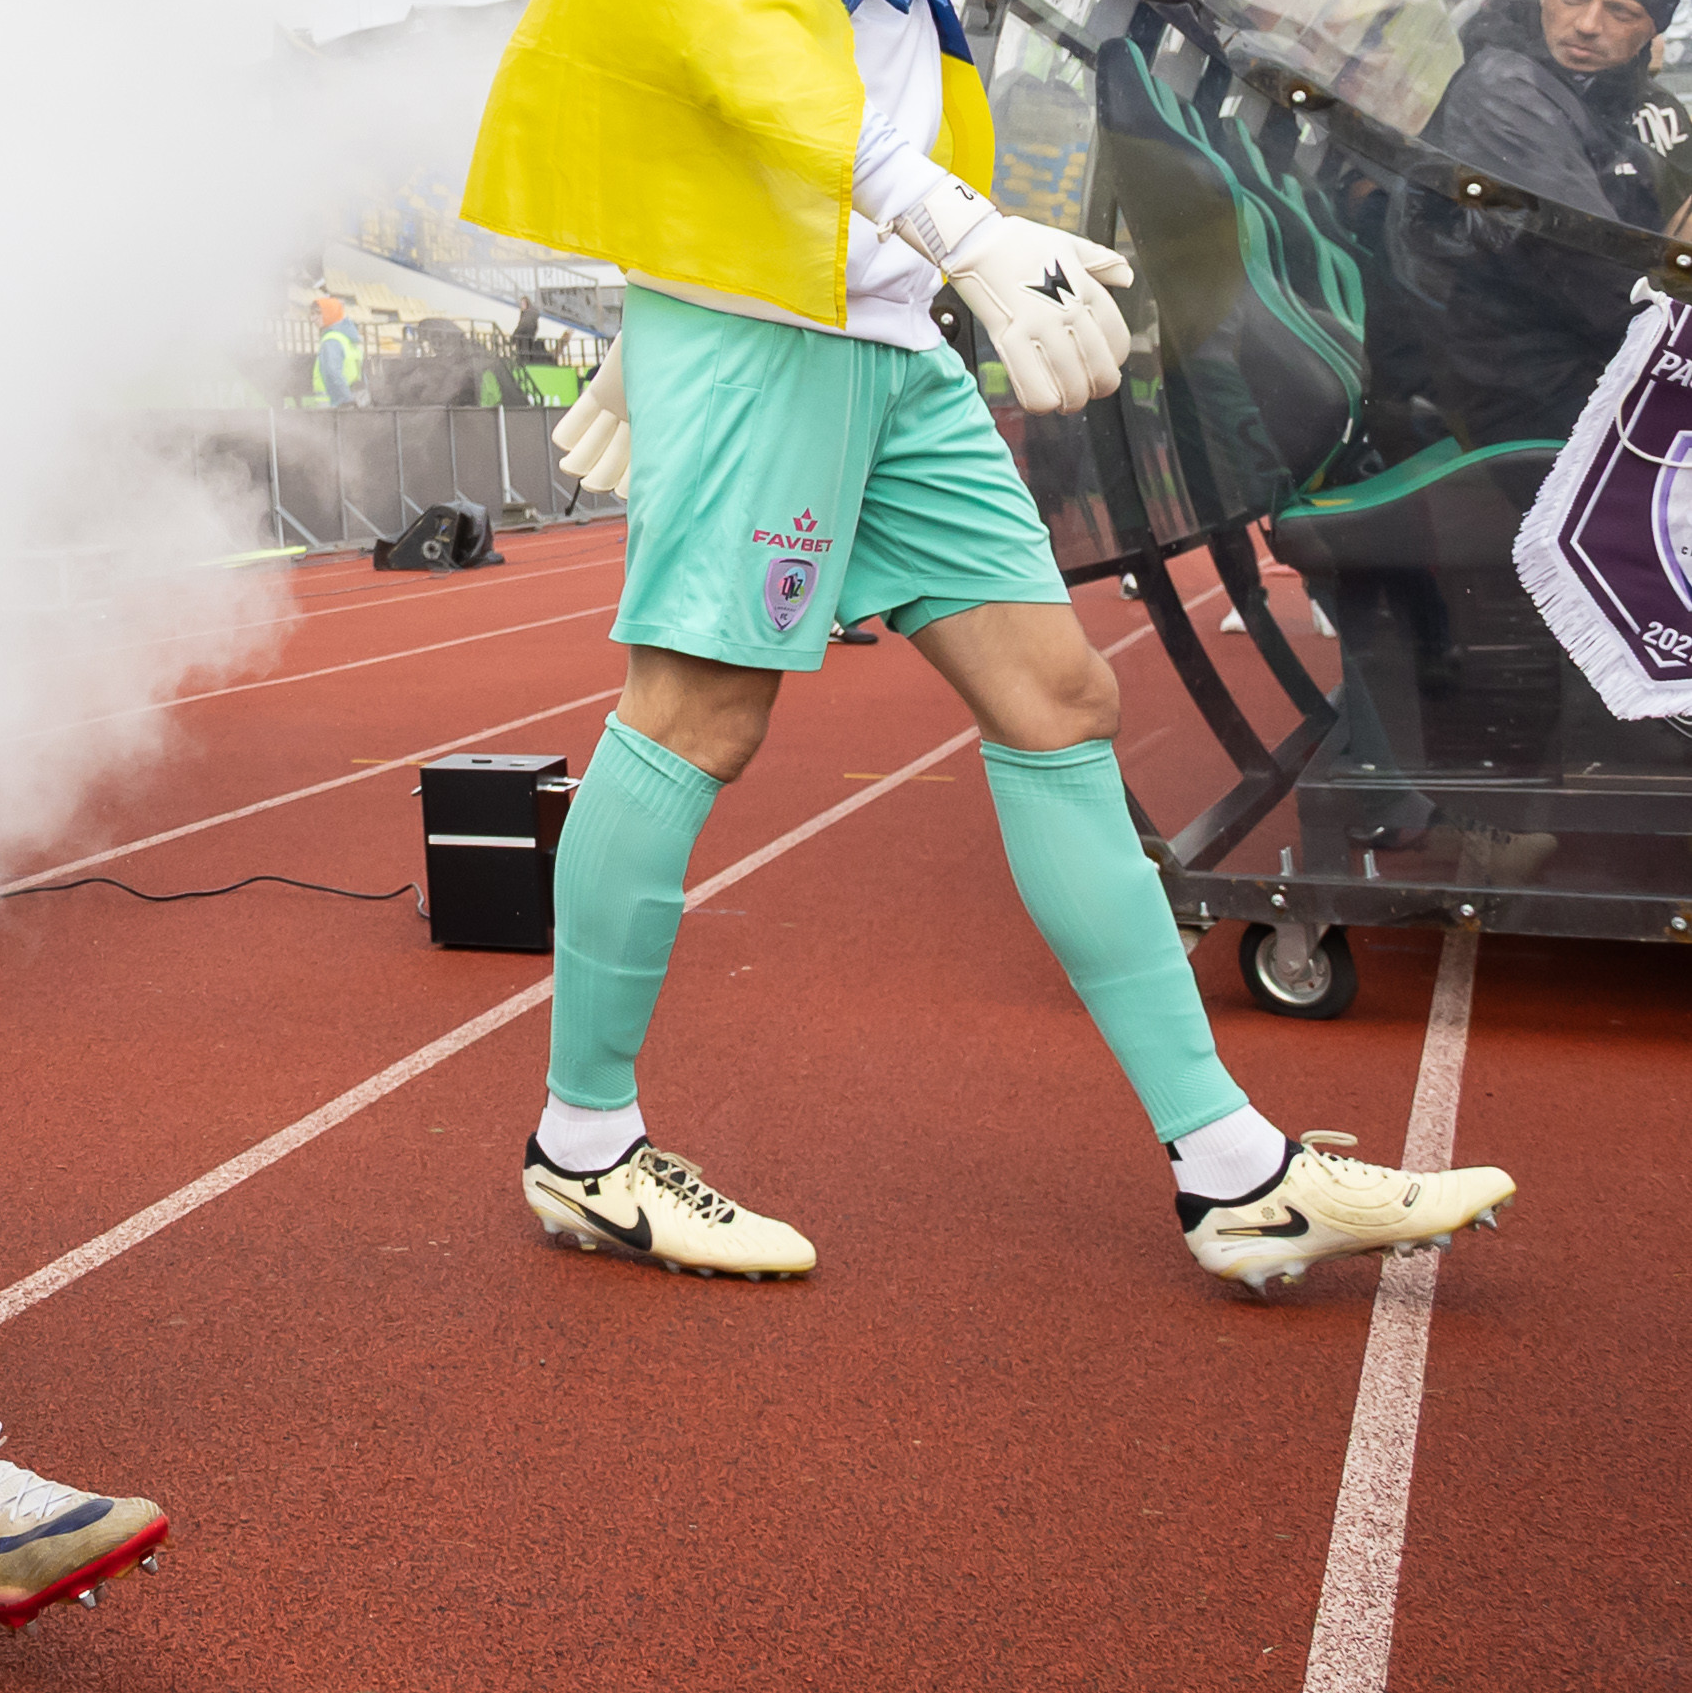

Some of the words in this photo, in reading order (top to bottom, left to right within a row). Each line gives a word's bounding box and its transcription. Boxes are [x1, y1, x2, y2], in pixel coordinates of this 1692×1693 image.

[1651, 349, 1692, 388] PA
[752, 529, 833, 553] FAVBET
[1642, 620, 1692, 664] 202
